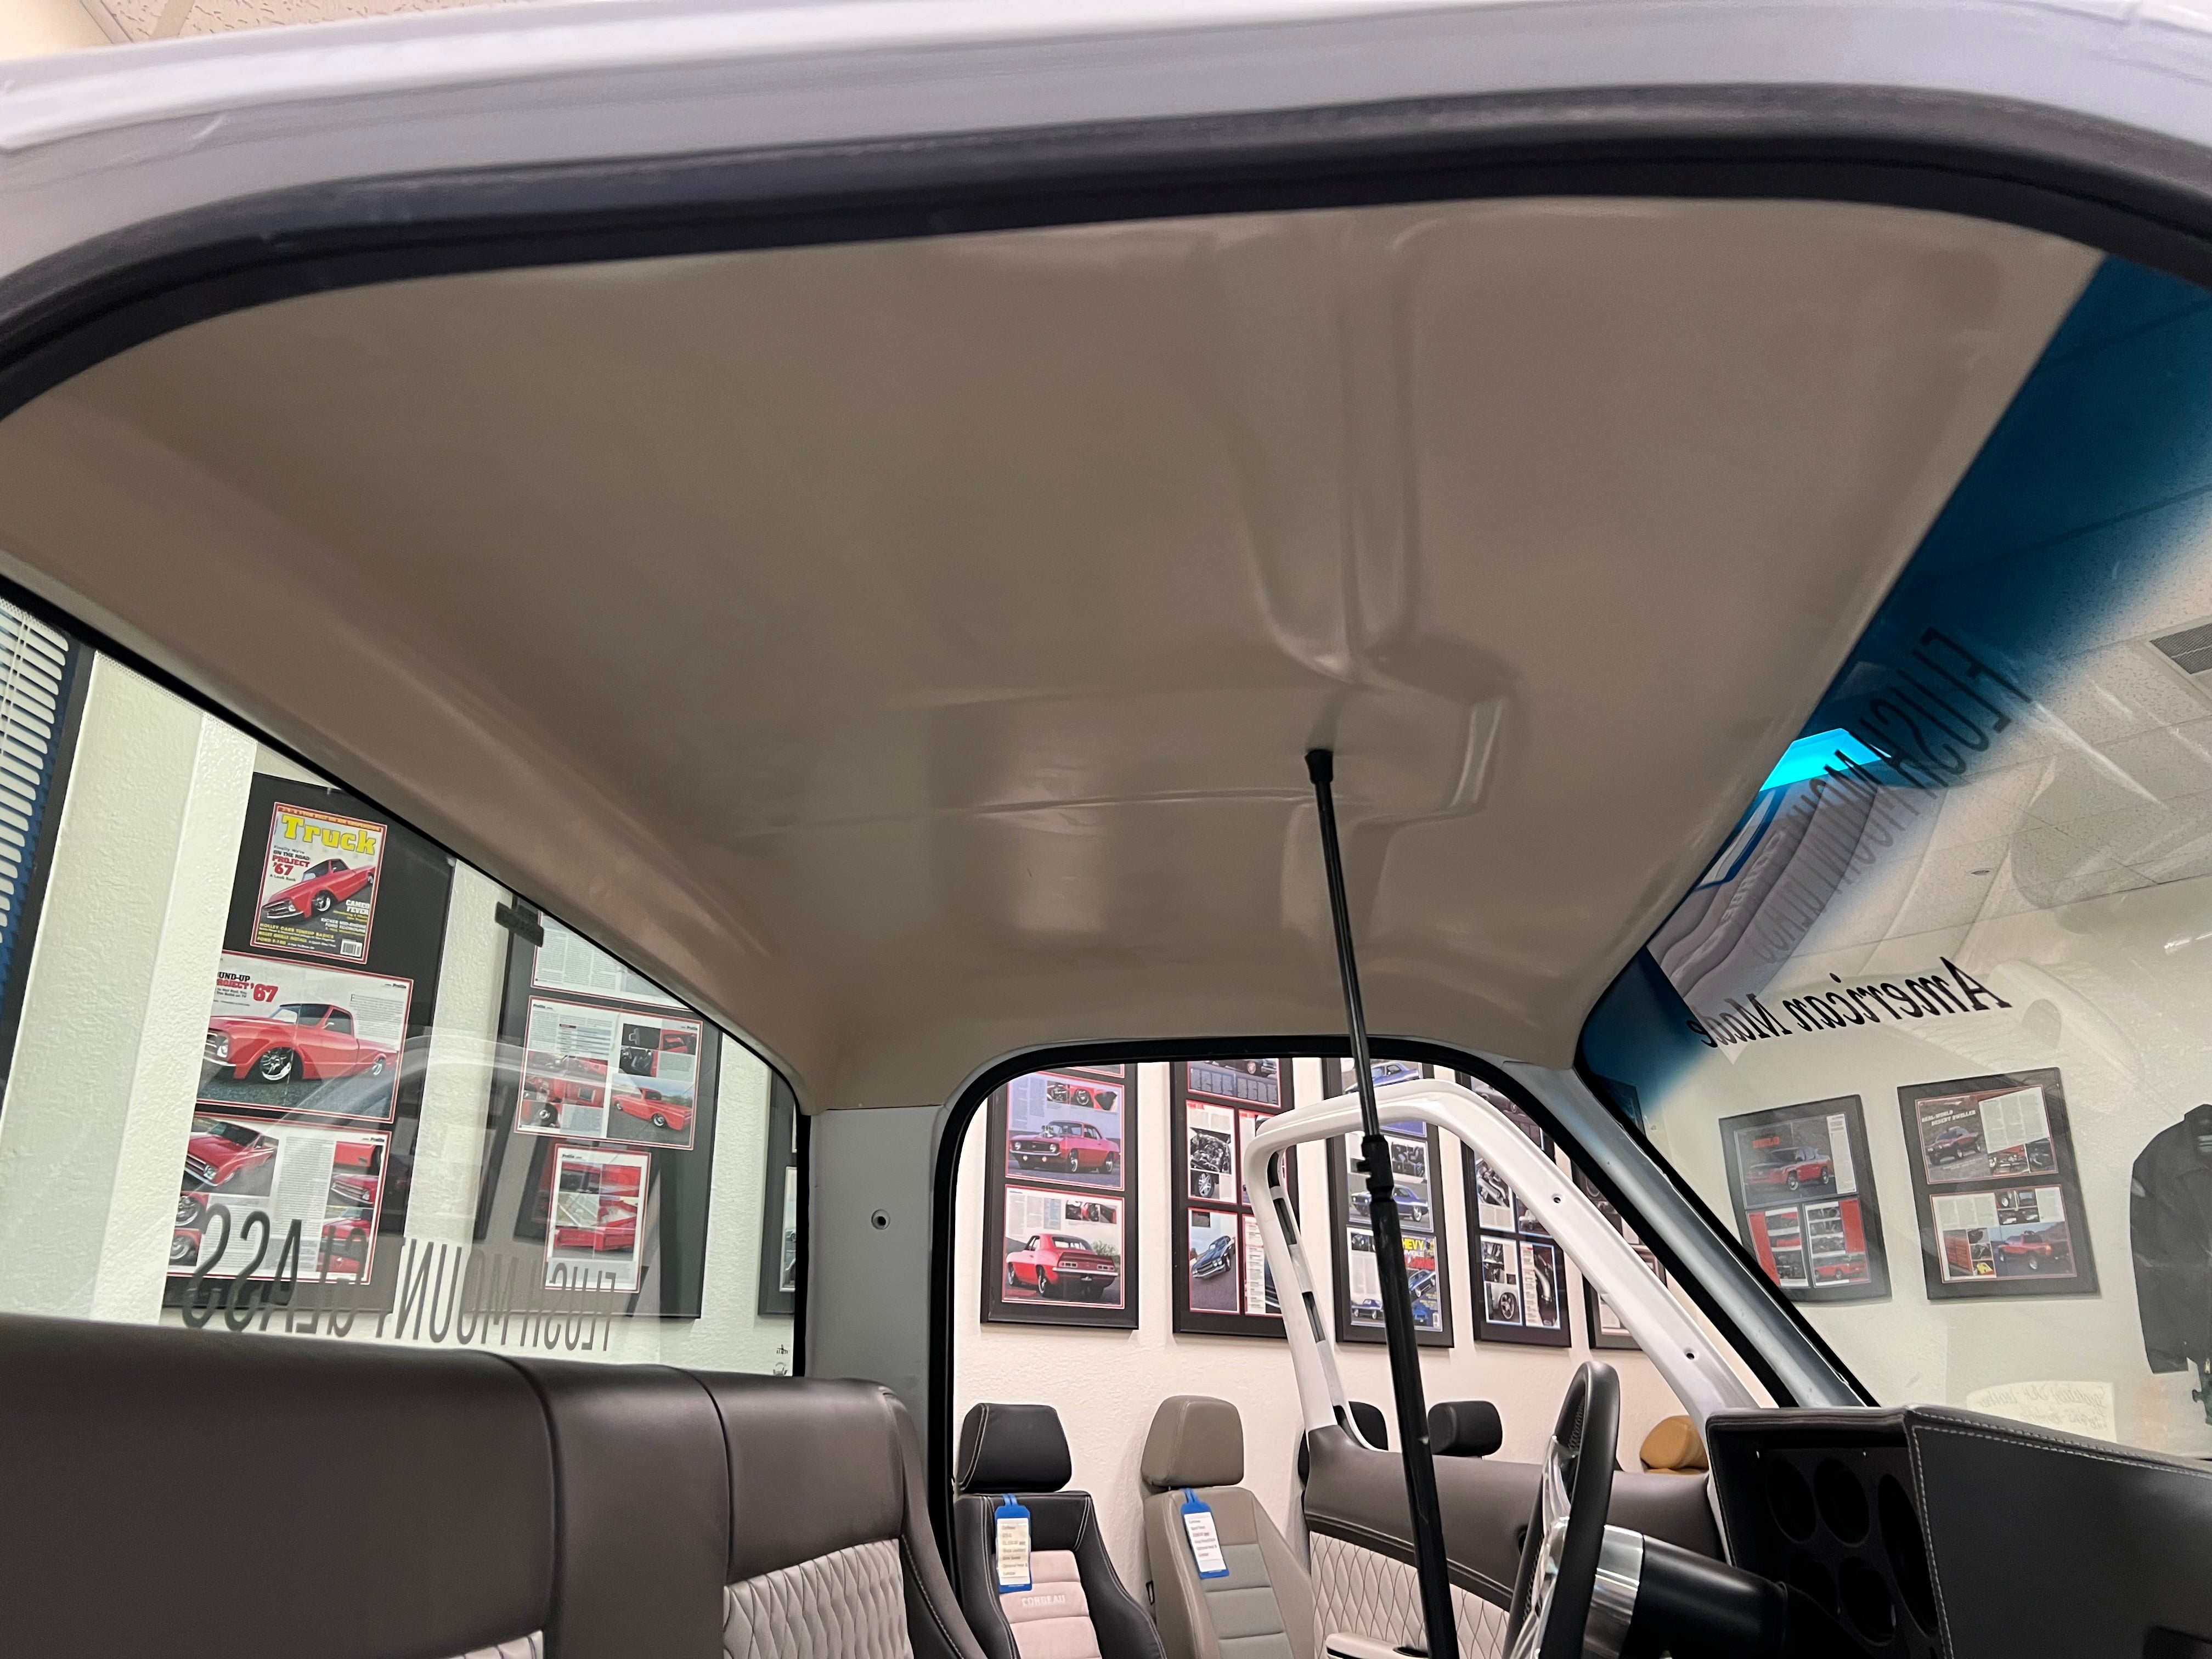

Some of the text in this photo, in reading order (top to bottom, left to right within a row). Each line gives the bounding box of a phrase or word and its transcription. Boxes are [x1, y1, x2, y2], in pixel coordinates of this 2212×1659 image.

[281, 814, 376, 855] Truck
[272, 855, 310, 867] PROJECT
[273, 863, 294, 876] '67
[218, 972, 250, 981] UND-UP
[217, 979, 249, 989] ROJECT
[250, 982, 279, 1003] '67
[1402, 1238, 1424, 1251] HEVY
